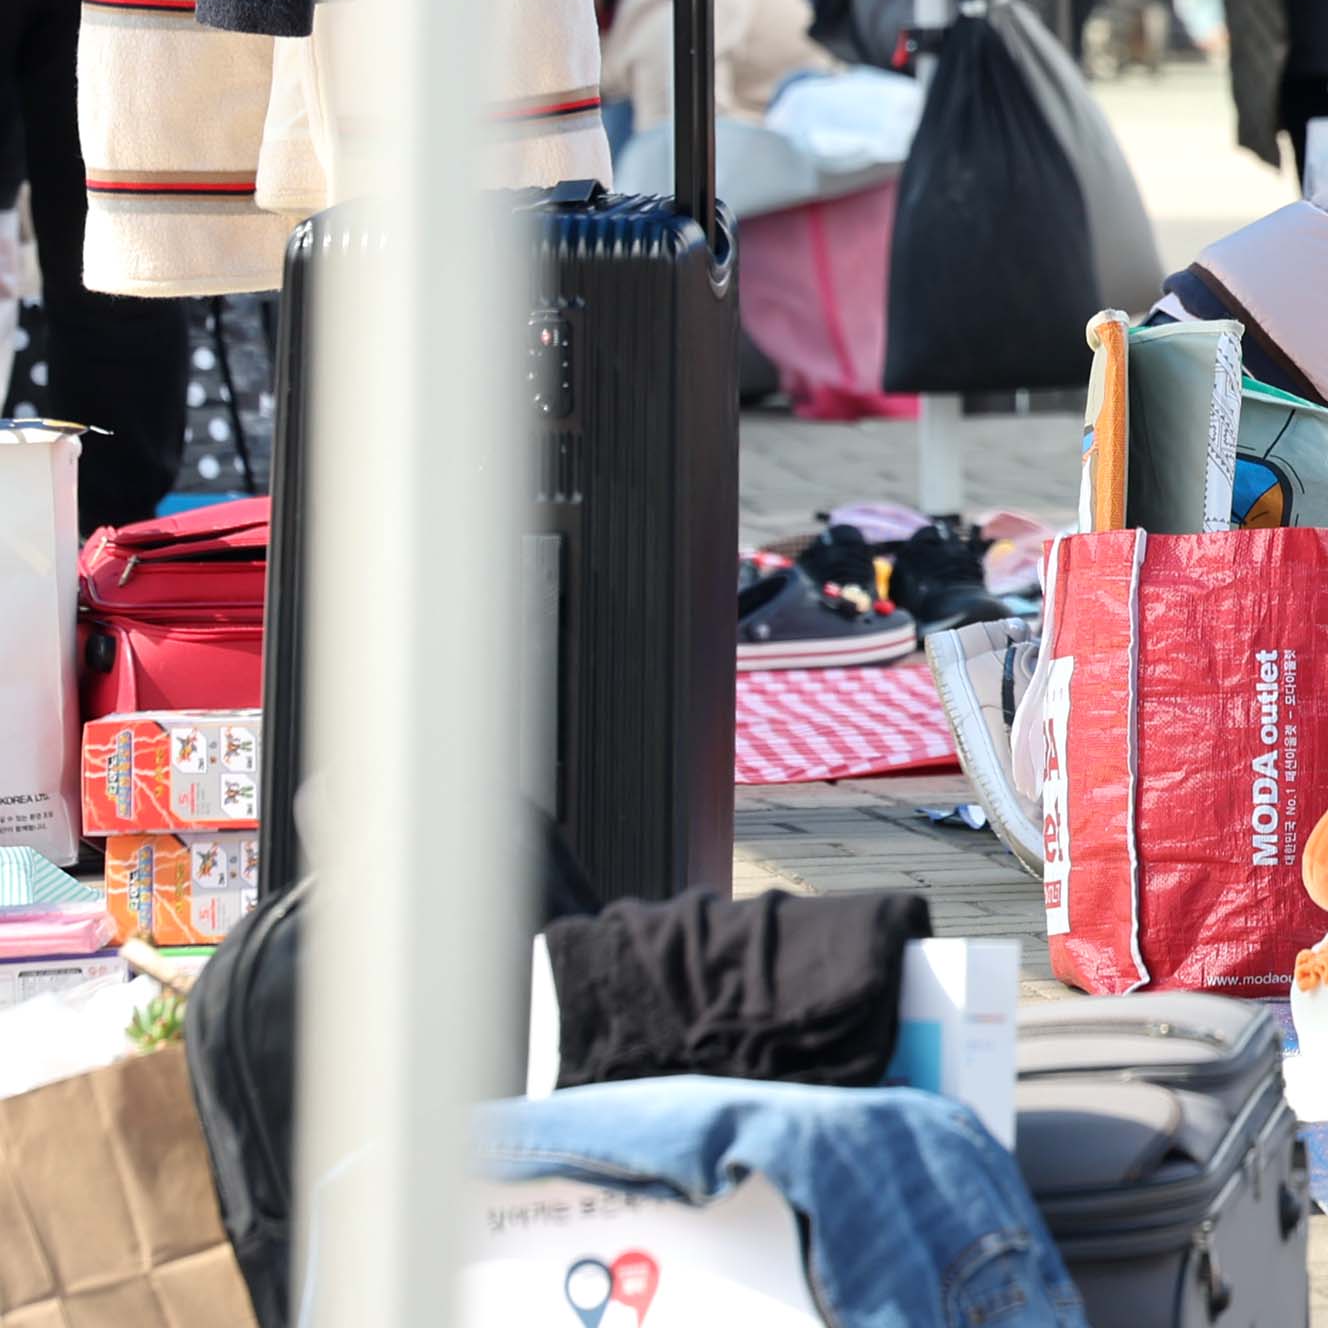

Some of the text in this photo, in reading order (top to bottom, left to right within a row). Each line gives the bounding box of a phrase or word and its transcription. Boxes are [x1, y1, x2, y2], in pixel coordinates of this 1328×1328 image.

[1284, 649, 1297, 706] 모다아울렛
[1252, 649, 1279, 865] MODA outlet
[1284, 724, 1297, 783] 패션아울렛
[1285, 788, 1297, 816] No.1
[1284, 820, 1297, 865] 대한민국
